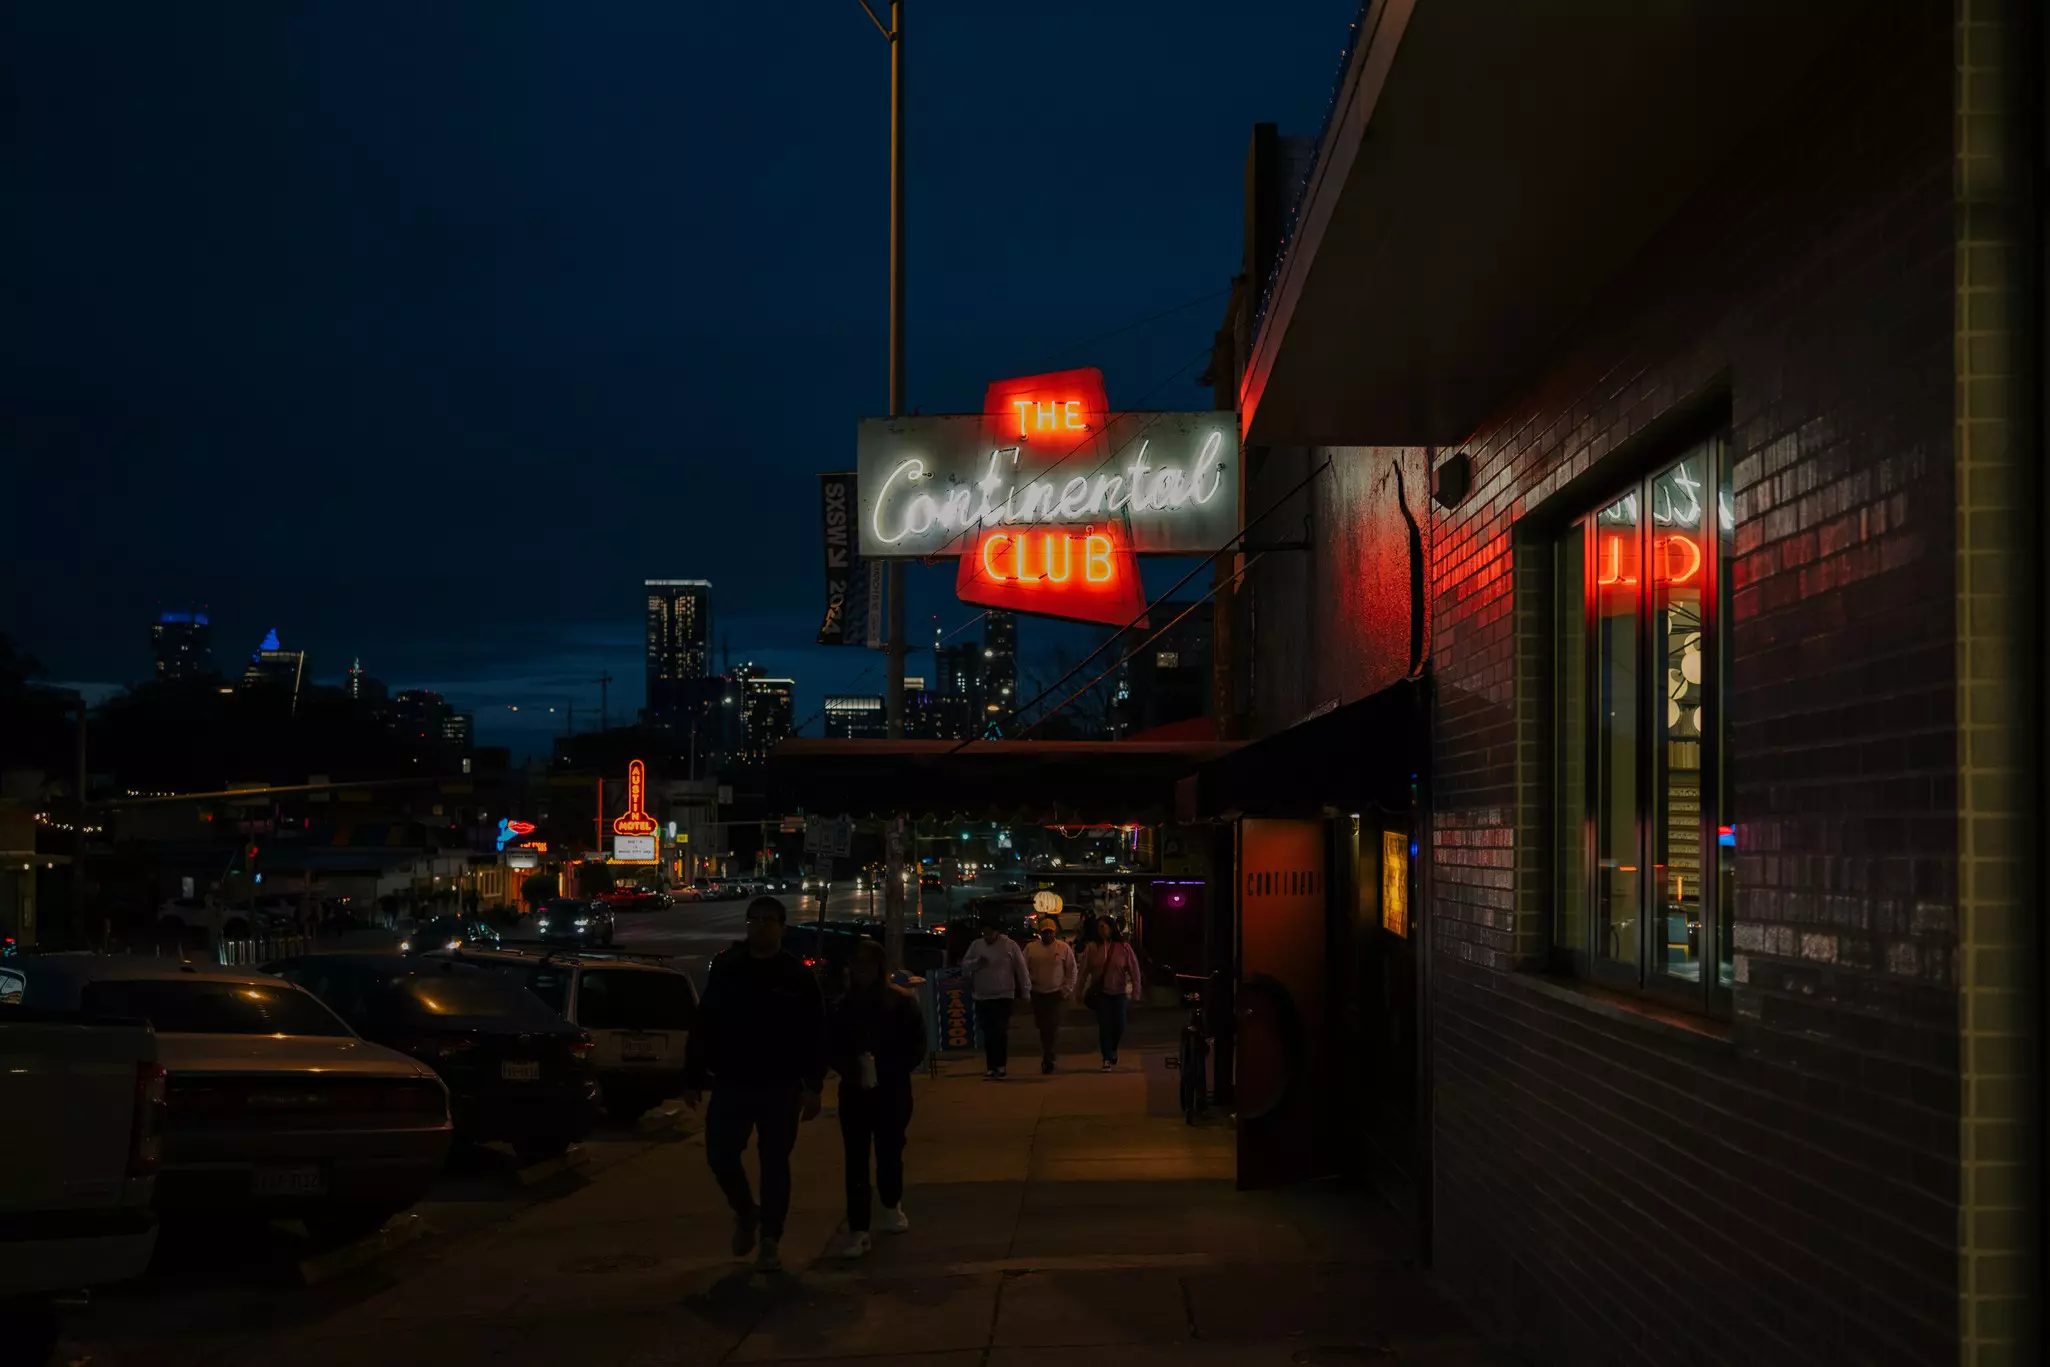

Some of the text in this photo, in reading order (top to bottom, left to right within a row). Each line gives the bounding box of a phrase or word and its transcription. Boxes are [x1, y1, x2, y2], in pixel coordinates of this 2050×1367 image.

[1013, 400, 1087, 434] THE
[872, 430, 1225, 544] Continental
[824, 482, 848, 634] SXSW 2024
[982, 534, 1114, 583] CLUB
[631, 766, 641, 820] AUSTIN
[618, 821, 652, 831] MOTEL
